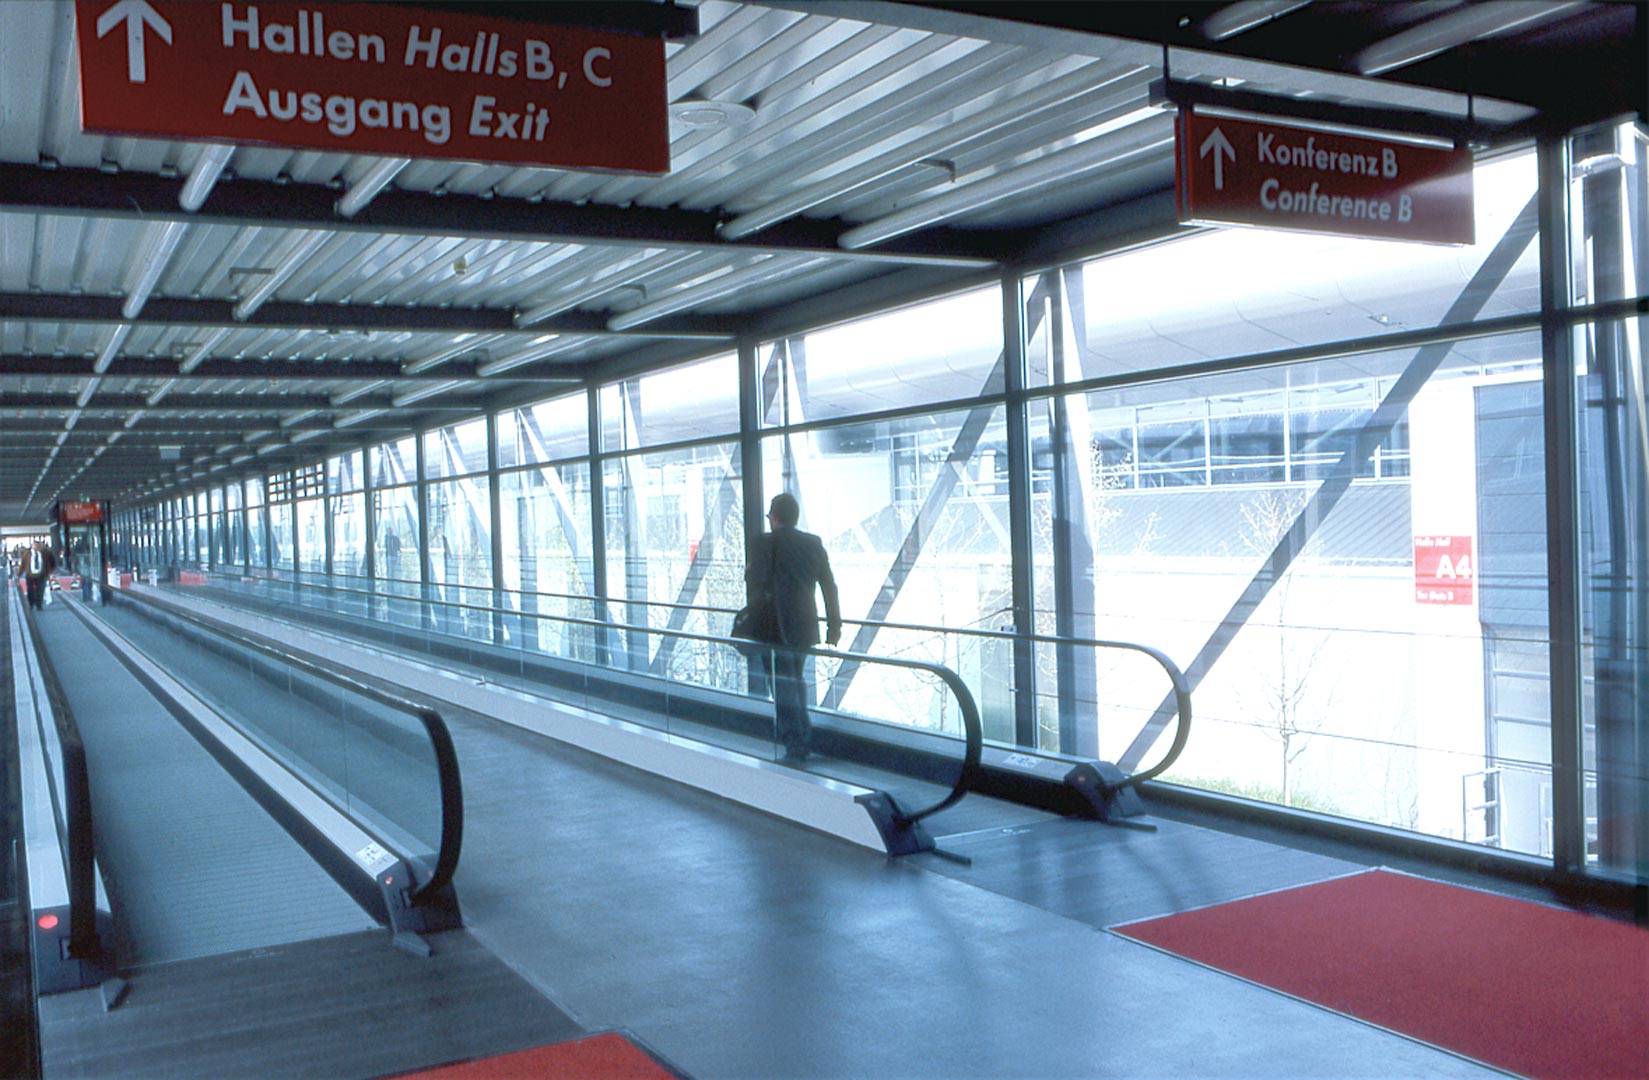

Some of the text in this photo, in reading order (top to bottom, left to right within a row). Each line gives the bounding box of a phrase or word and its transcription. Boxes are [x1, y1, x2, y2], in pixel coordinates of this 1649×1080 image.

[221, 3, 385, 63] Hallen
[404, 27, 517, 77] Halls
[582, 47, 612, 87] C
[222, 71, 550, 144] Ausgang Exit
[1258, 131, 1398, 178] Konferenz B
[1260, 178, 1412, 223] Conference B
[1435, 554, 1473, 579] A4
